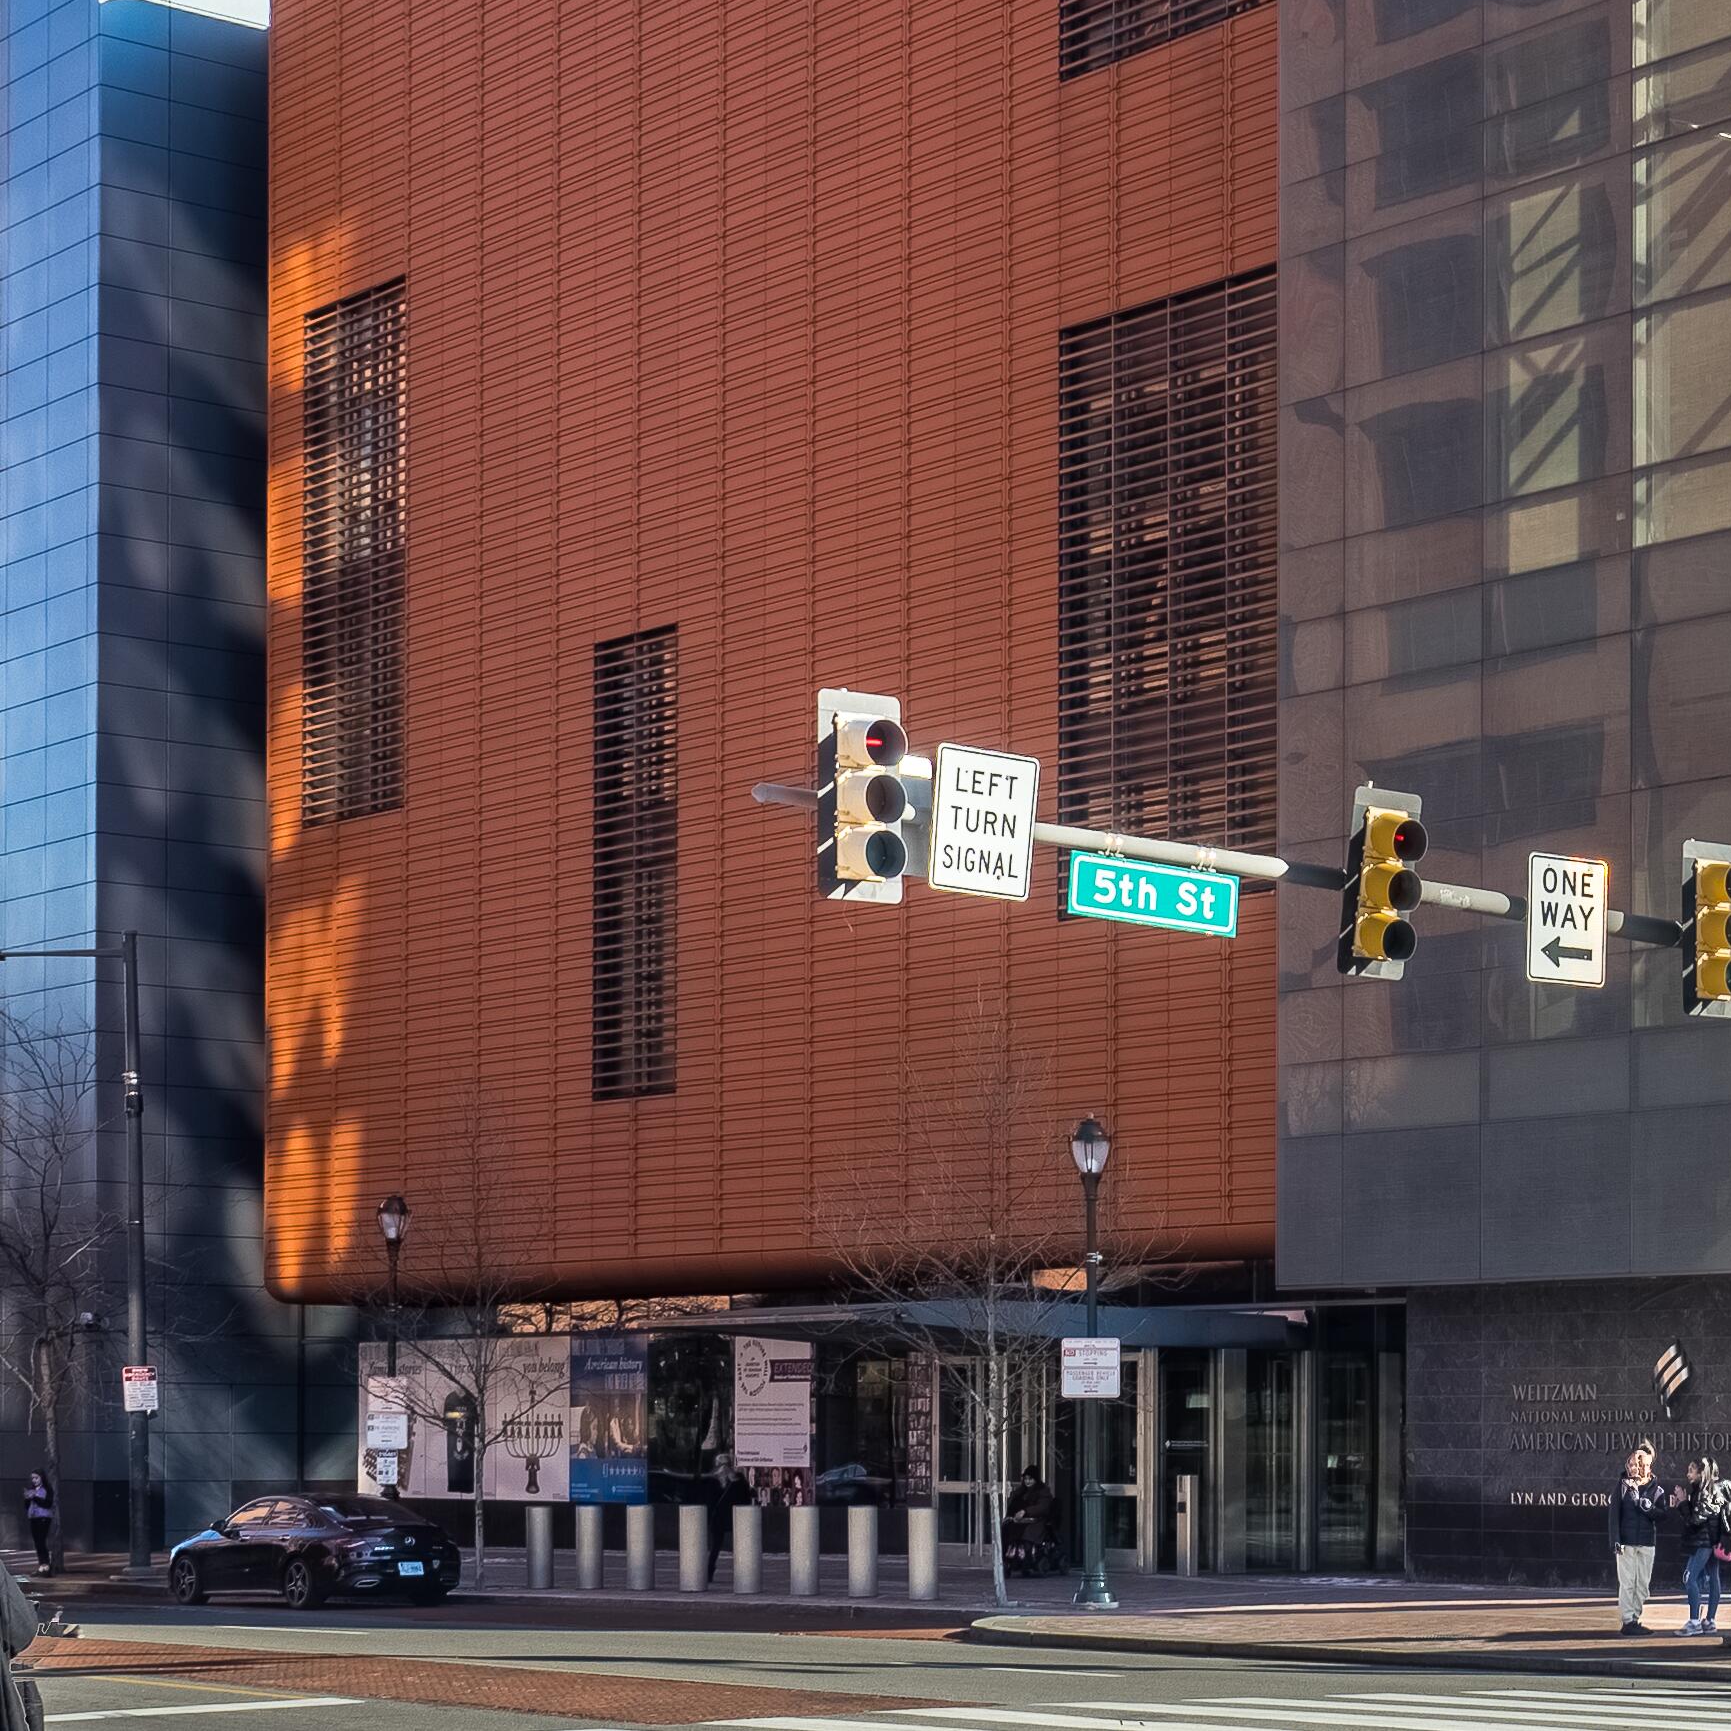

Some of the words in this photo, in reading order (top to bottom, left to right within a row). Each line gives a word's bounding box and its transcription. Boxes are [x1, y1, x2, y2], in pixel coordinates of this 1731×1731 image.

[955, 767, 1019, 800] LEFT
[950, 805, 1017, 839] TURN
[942, 844, 1019, 880] SIGNAL
[1093, 871, 1157, 911] 5th
[1176, 882, 1216, 920] St
[1542, 867, 1594, 899] ONE
[1541, 900, 1594, 932] WAY
[1512, 1384, 1597, 1402] WEITZMAN
[1510, 1410, 1577, 1423] NATIONAL
[1580, 1410, 1635, 1423] MUSEUM
[1639, 1409, 1657, 1423] OF
[1510, 1431, 1597, 1451] AMERICAN
[1510, 1492, 1534, 1505] LYN
[1539, 1492, 1567, 1506] AND
[1572, 1493, 1612, 1507] GEOR
